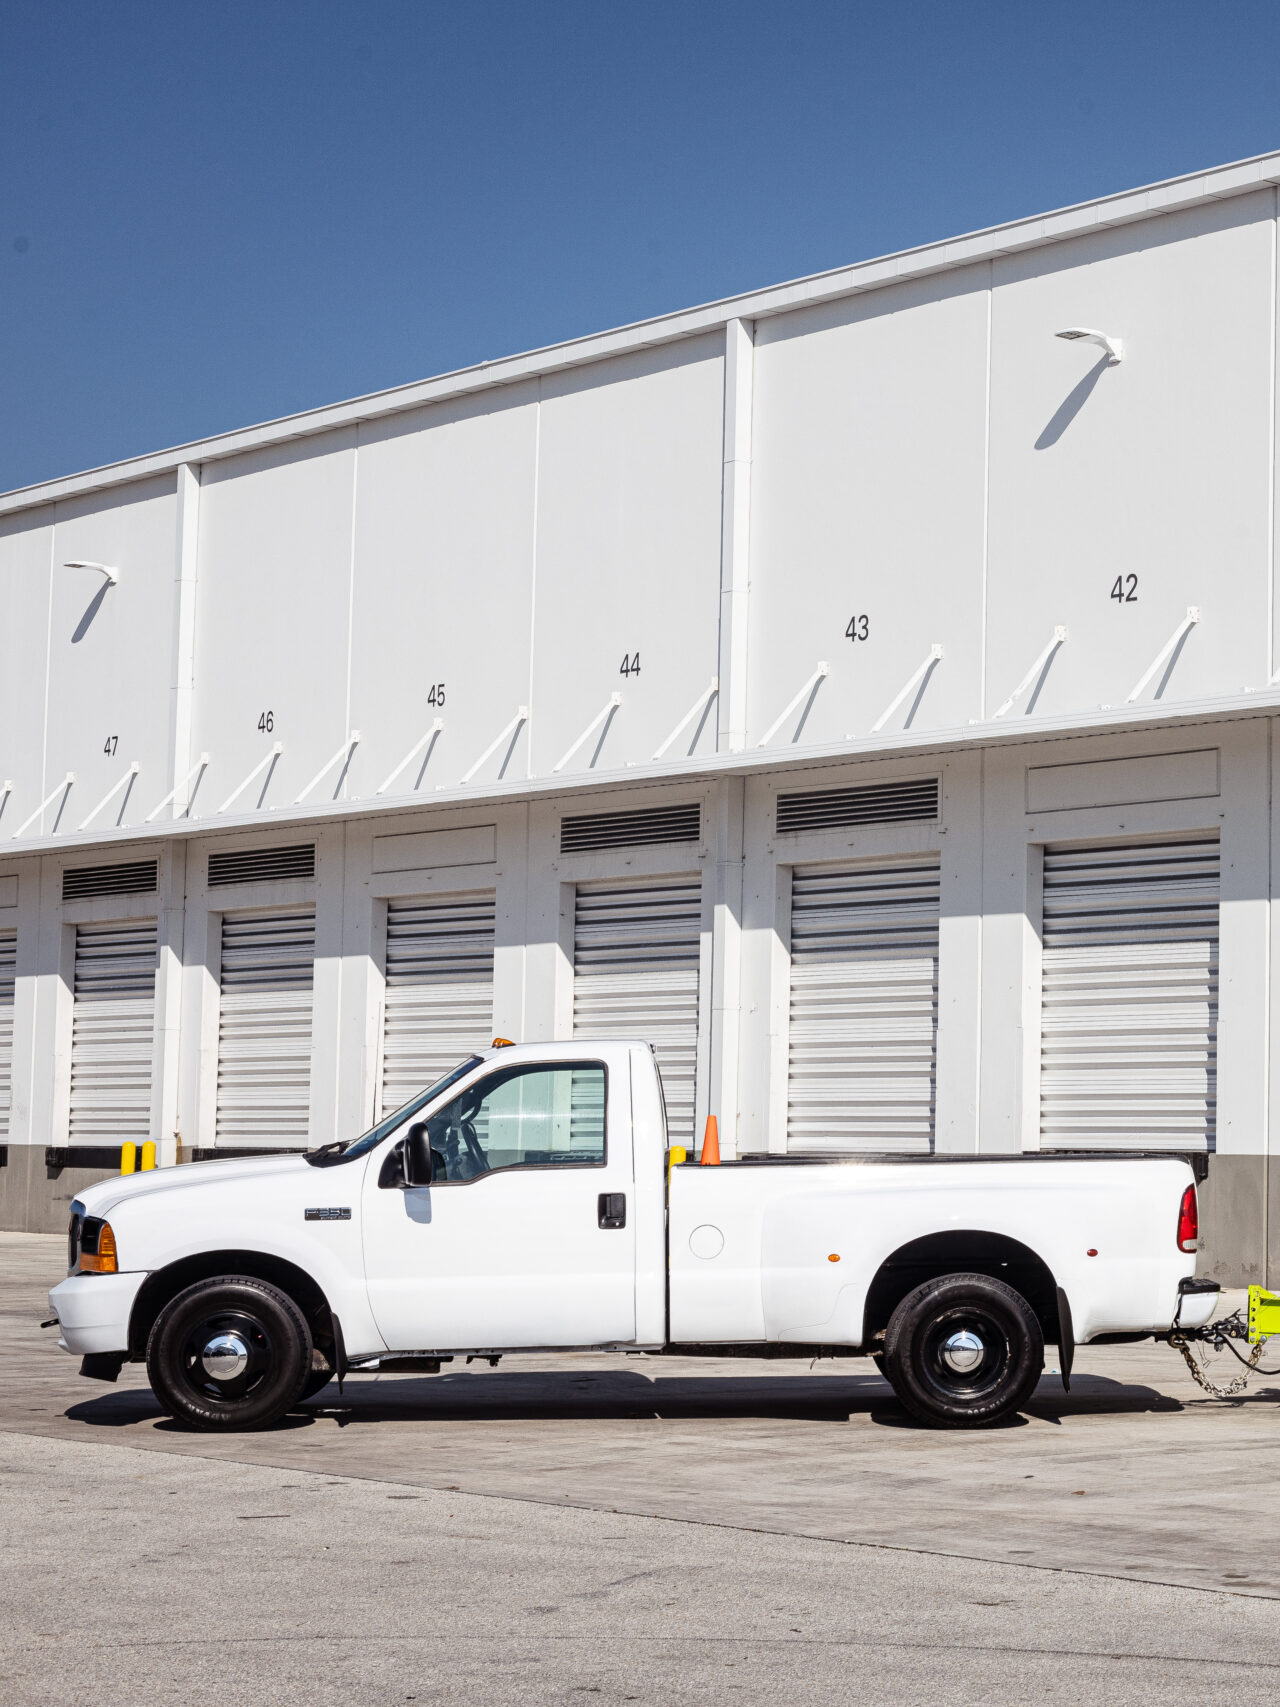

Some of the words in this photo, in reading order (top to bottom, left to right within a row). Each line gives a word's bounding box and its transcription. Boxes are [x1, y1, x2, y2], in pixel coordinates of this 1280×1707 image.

[1110, 573, 1138, 603] 42
[845, 614, 869, 642] 43
[619, 652, 641, 678] 44
[427, 683, 446, 707] 45
[257, 710, 274, 733] 46
[103, 735, 119, 756] 47
